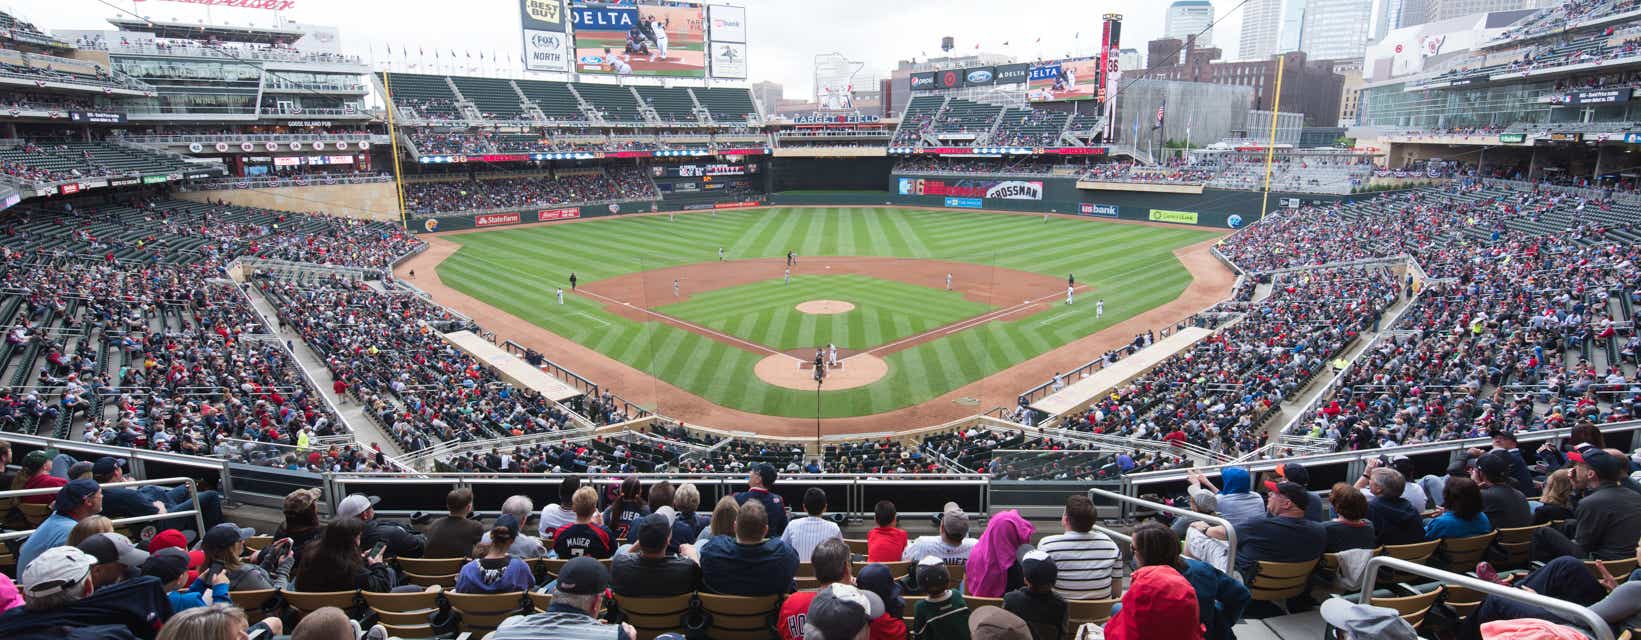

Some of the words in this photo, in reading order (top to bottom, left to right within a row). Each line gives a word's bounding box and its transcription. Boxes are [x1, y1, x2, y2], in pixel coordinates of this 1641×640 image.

[531, 1, 558, 11] BEST
[532, 9, 555, 19] BUY
[538, 36, 554, 45] FOX
[534, 52, 560, 62] NORTH
[1108, 59, 1119, 73] 36
[1004, 71, 1025, 79] DELTA
[794, 114, 837, 123] TARGET
[848, 114, 882, 123] FIELD
[991, 185, 1038, 199] GROSSMAN
[567, 537, 591, 550] MAUER
